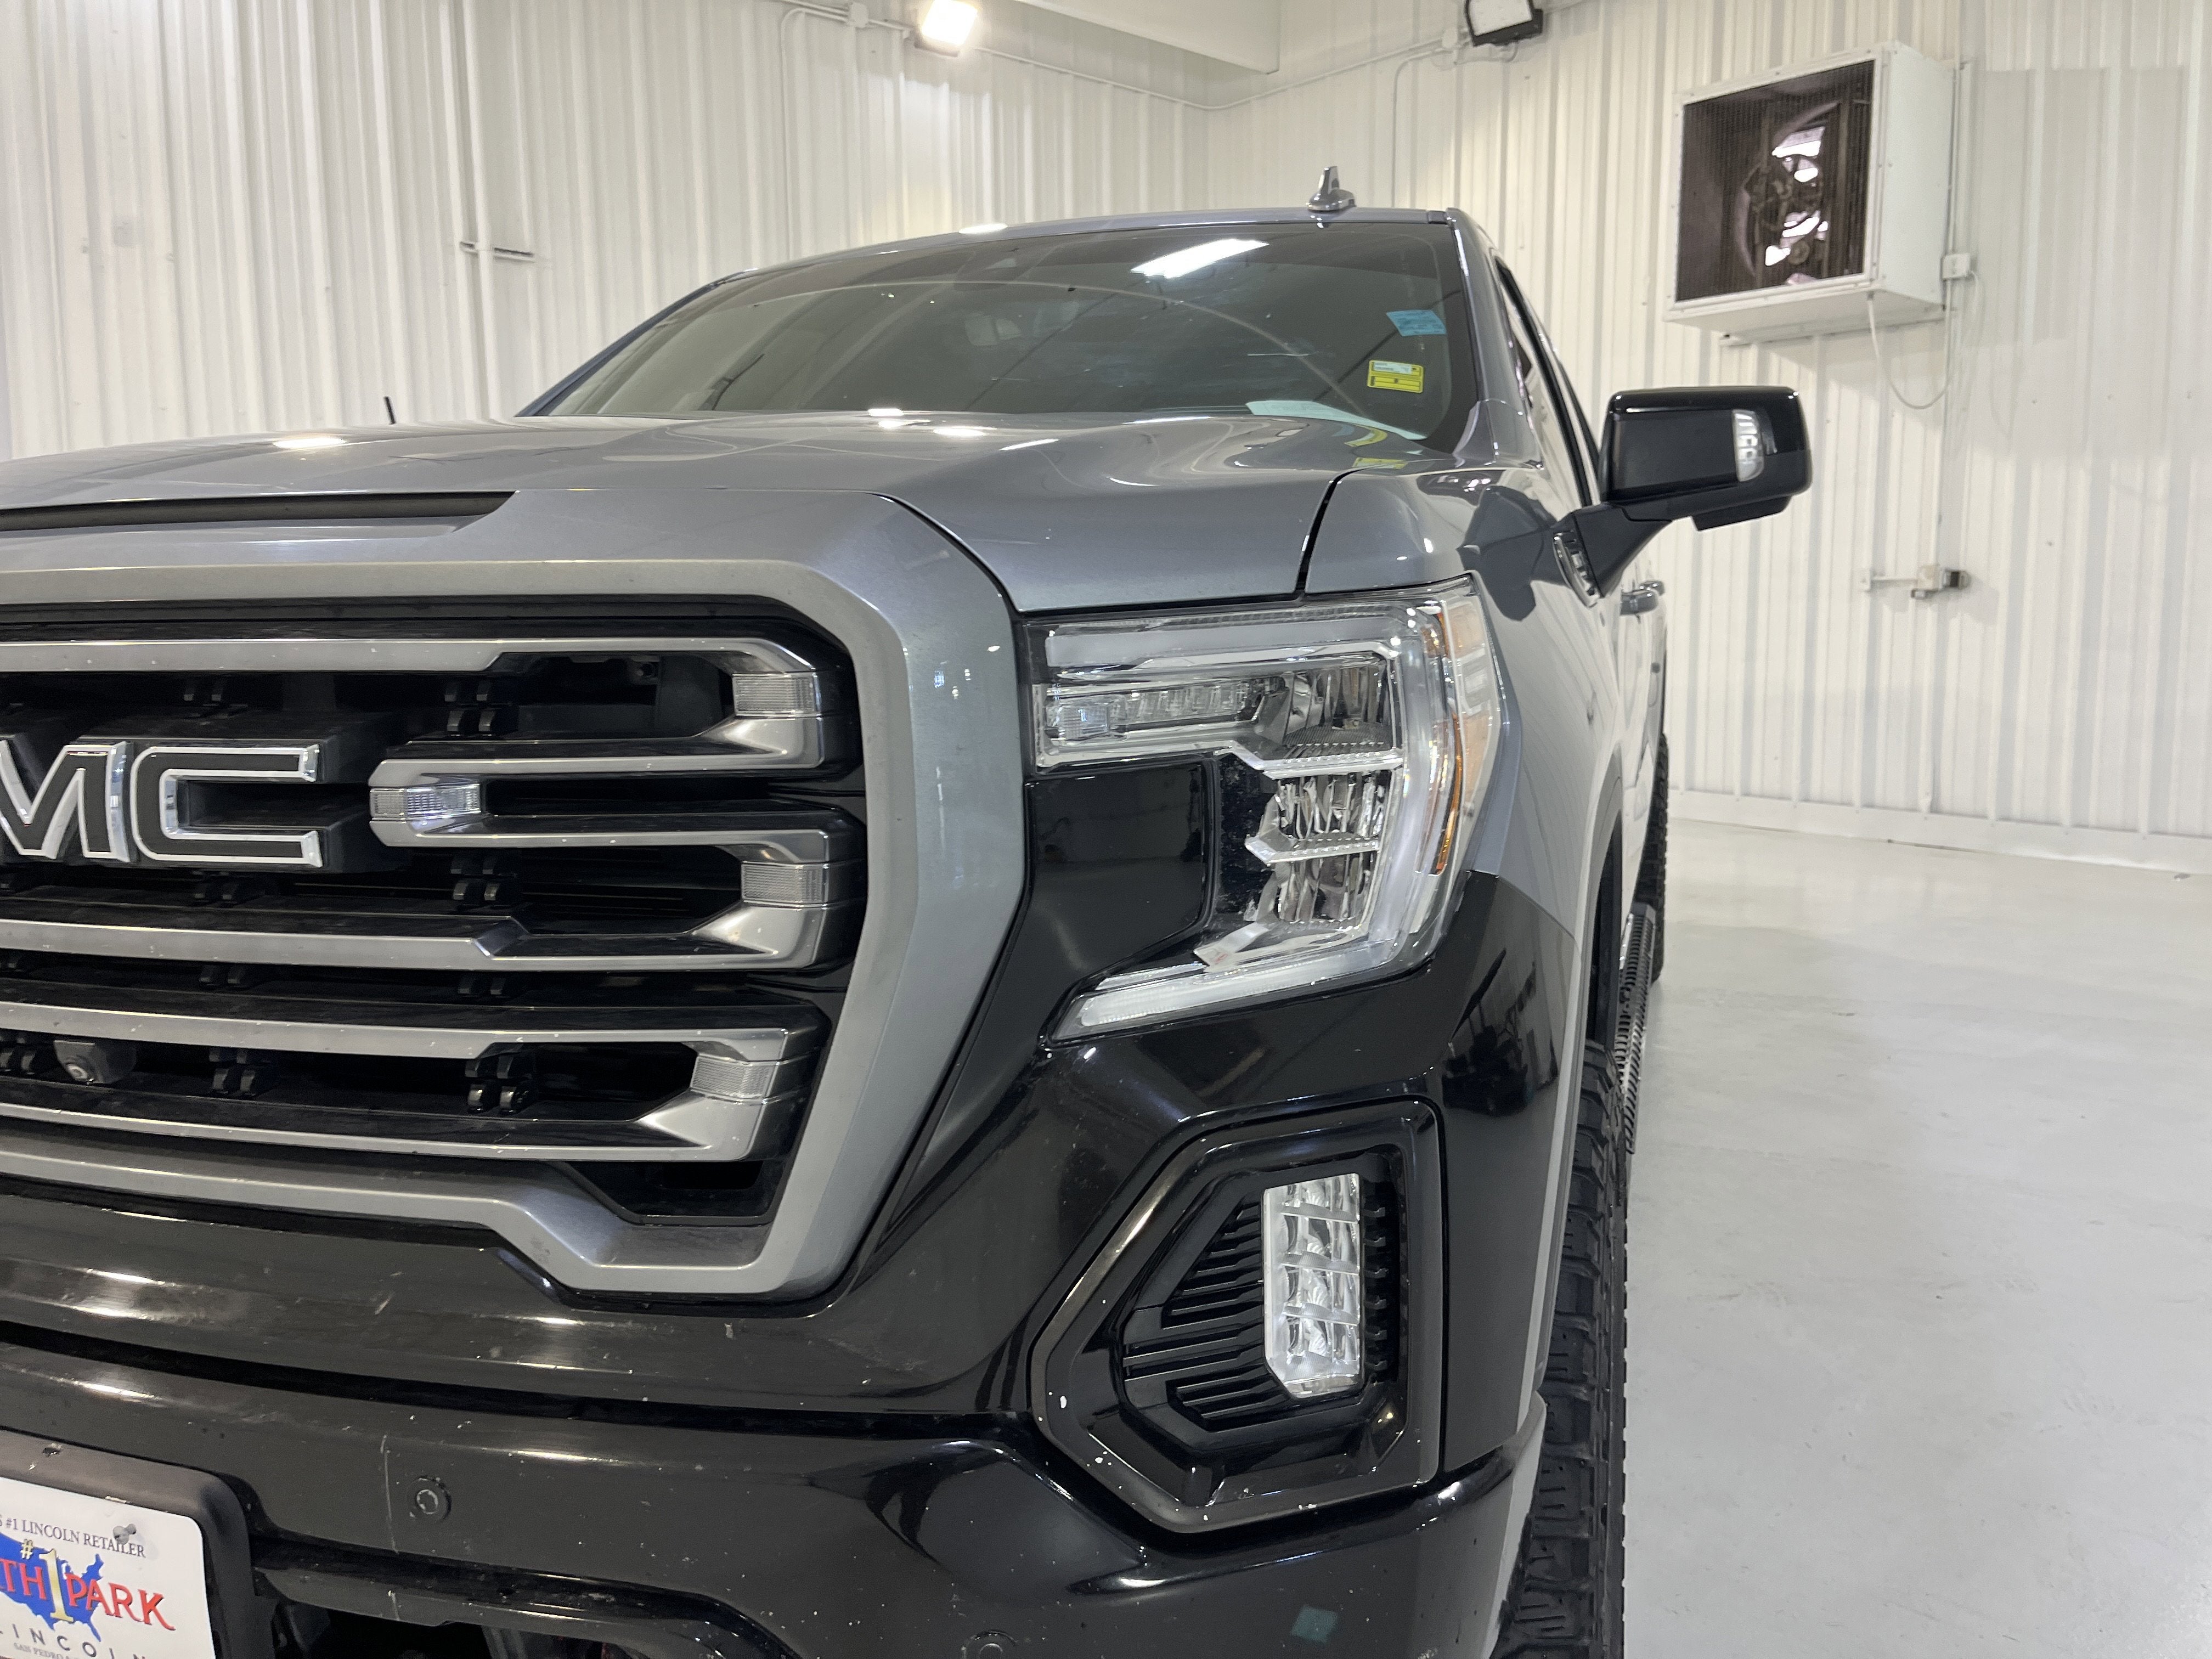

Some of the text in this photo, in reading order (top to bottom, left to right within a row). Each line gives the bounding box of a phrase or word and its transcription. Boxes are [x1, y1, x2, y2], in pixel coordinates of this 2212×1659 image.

[6, 1517, 18, 1530] #1
[22, 1520, 80, 1544] LINCOLN
[83, 1532, 146, 1558] RETAILER
[64, 1572, 176, 1630] PARK
